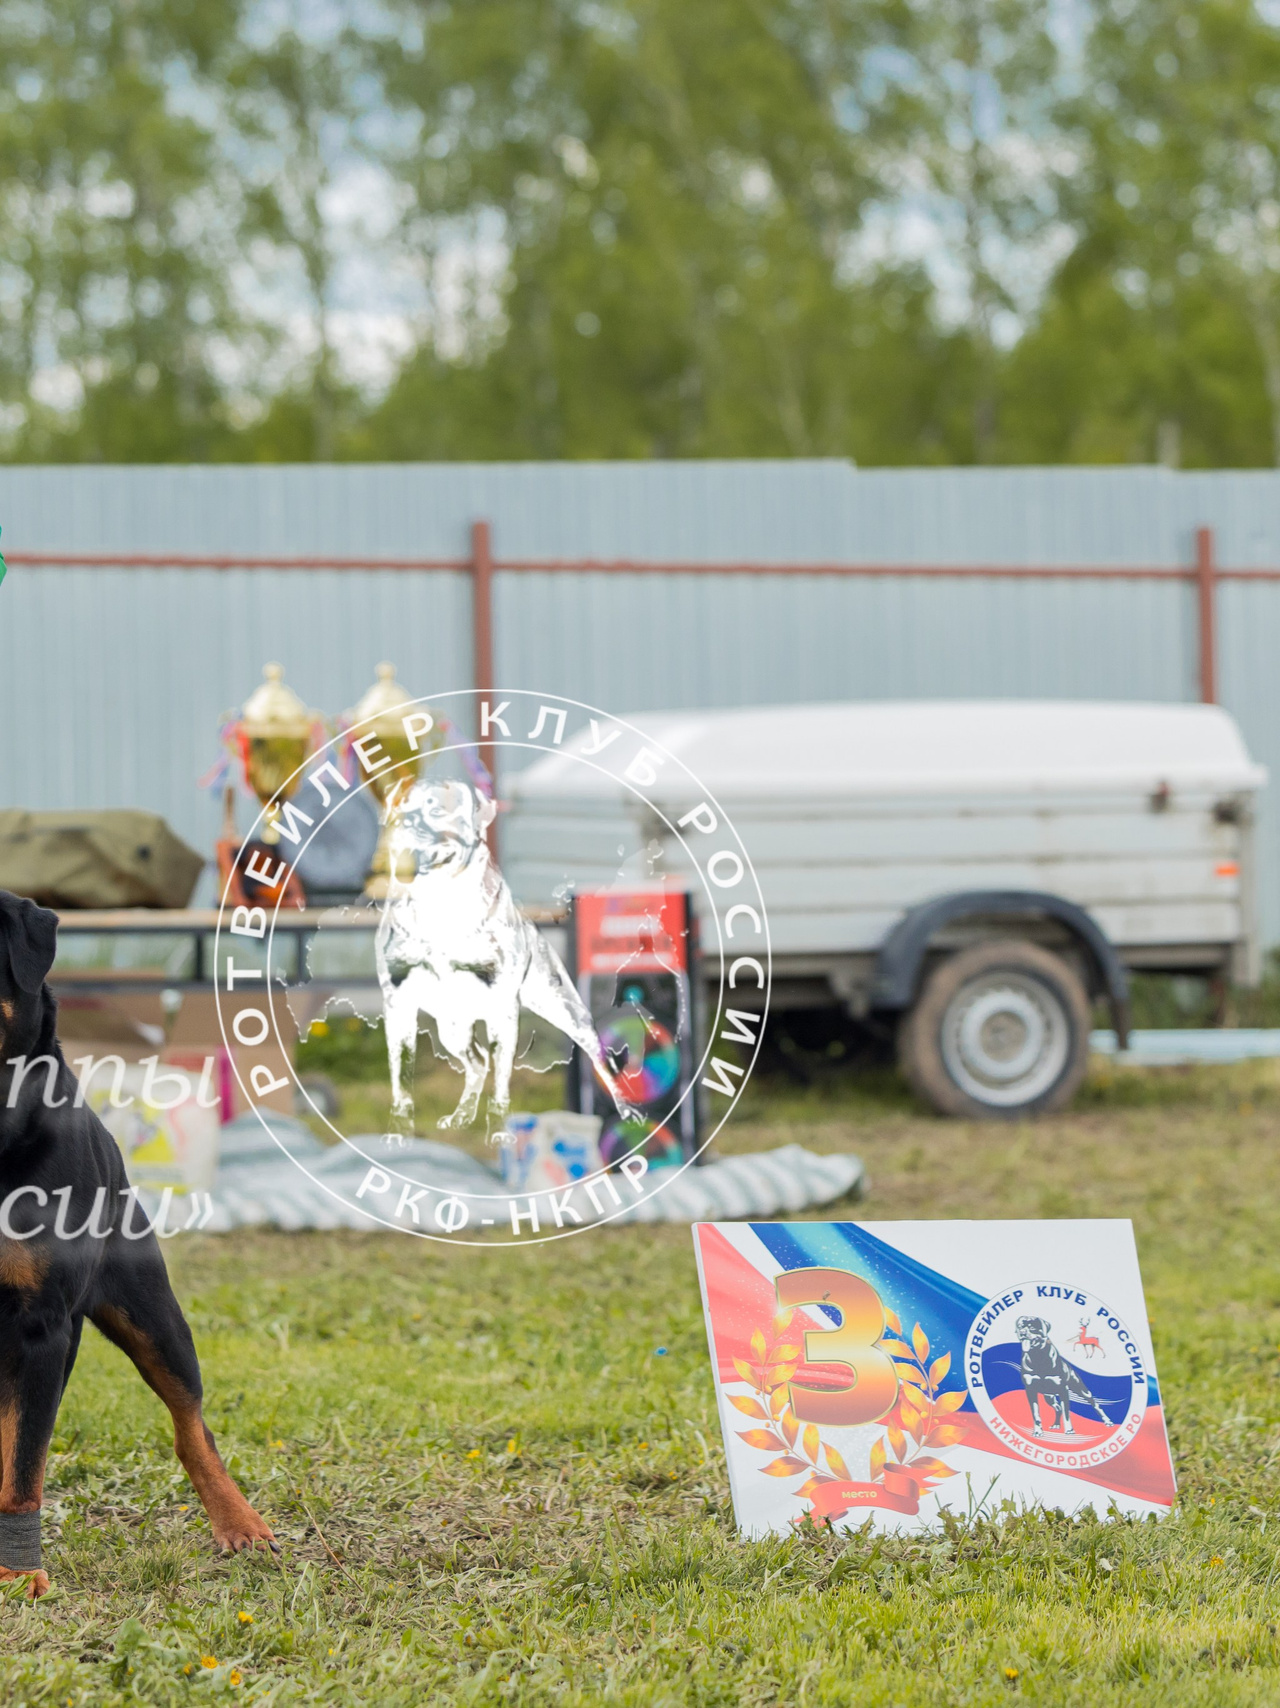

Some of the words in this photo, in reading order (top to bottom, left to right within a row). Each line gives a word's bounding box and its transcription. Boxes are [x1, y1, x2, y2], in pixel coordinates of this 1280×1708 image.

[773, 1266, 900, 1428] 3
[969, 1289, 1024, 1388] РОТВЕЙЛЕР
[1036, 1285, 1087, 1306] КЛУБ
[1096, 1306, 1145, 1384] РОССИИ
[989, 1416, 1128, 1468] НИЖЕГОРОДСКОЕ
[1127, 1413, 1142, 1436] РО
